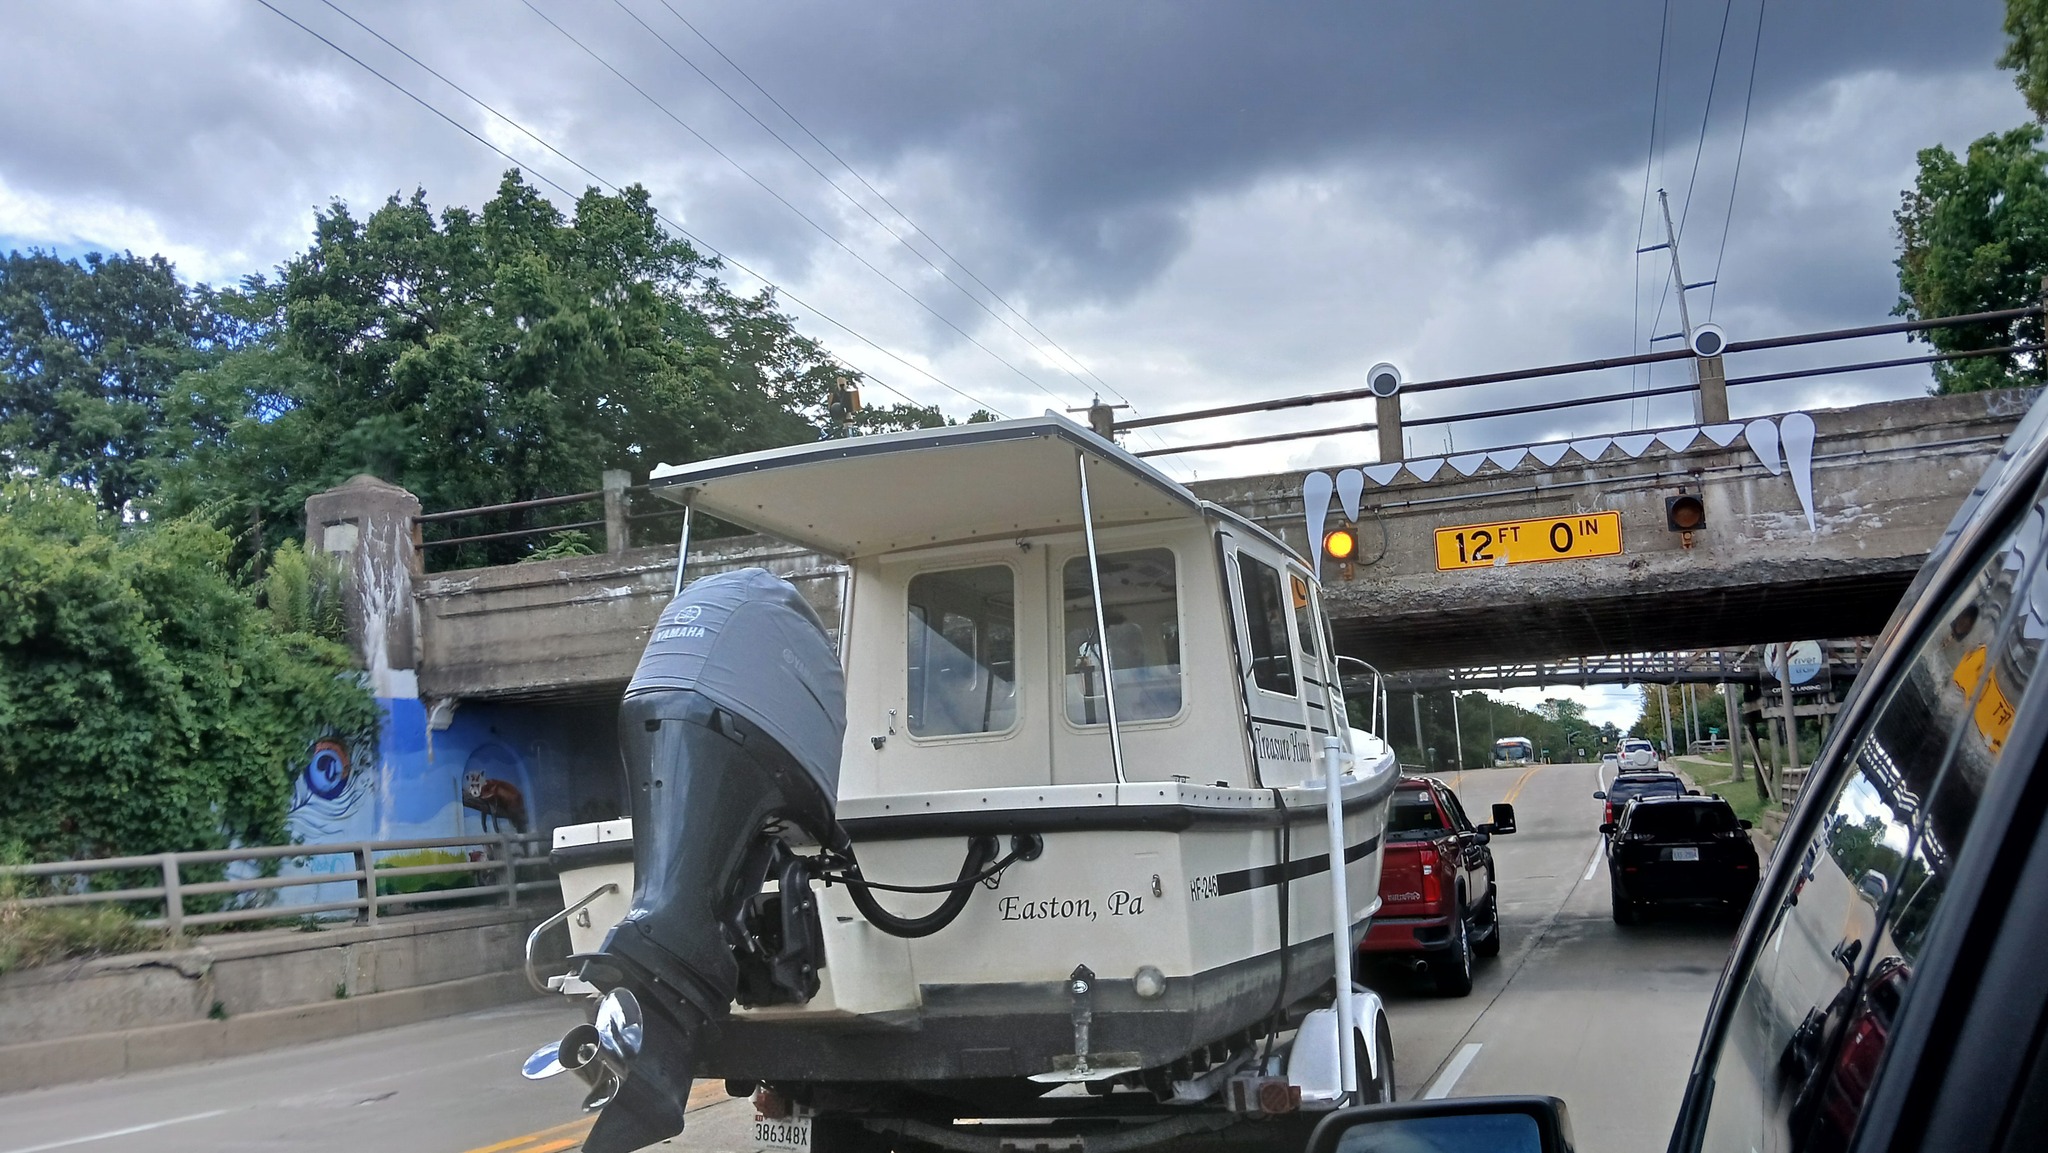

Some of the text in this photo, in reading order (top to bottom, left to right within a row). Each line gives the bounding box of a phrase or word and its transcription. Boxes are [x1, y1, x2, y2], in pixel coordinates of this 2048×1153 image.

[1455, 518, 1599, 563] 12 FT 0 IN
[656, 626, 705, 641] YAMAHA
[1253, 724, 1290, 760] Treasure
[1190, 875, 1217, 902] HF-246
[998, 890, 1145, 922] Easton, Pa
[755, 1123, 807, 1146] 386348X
